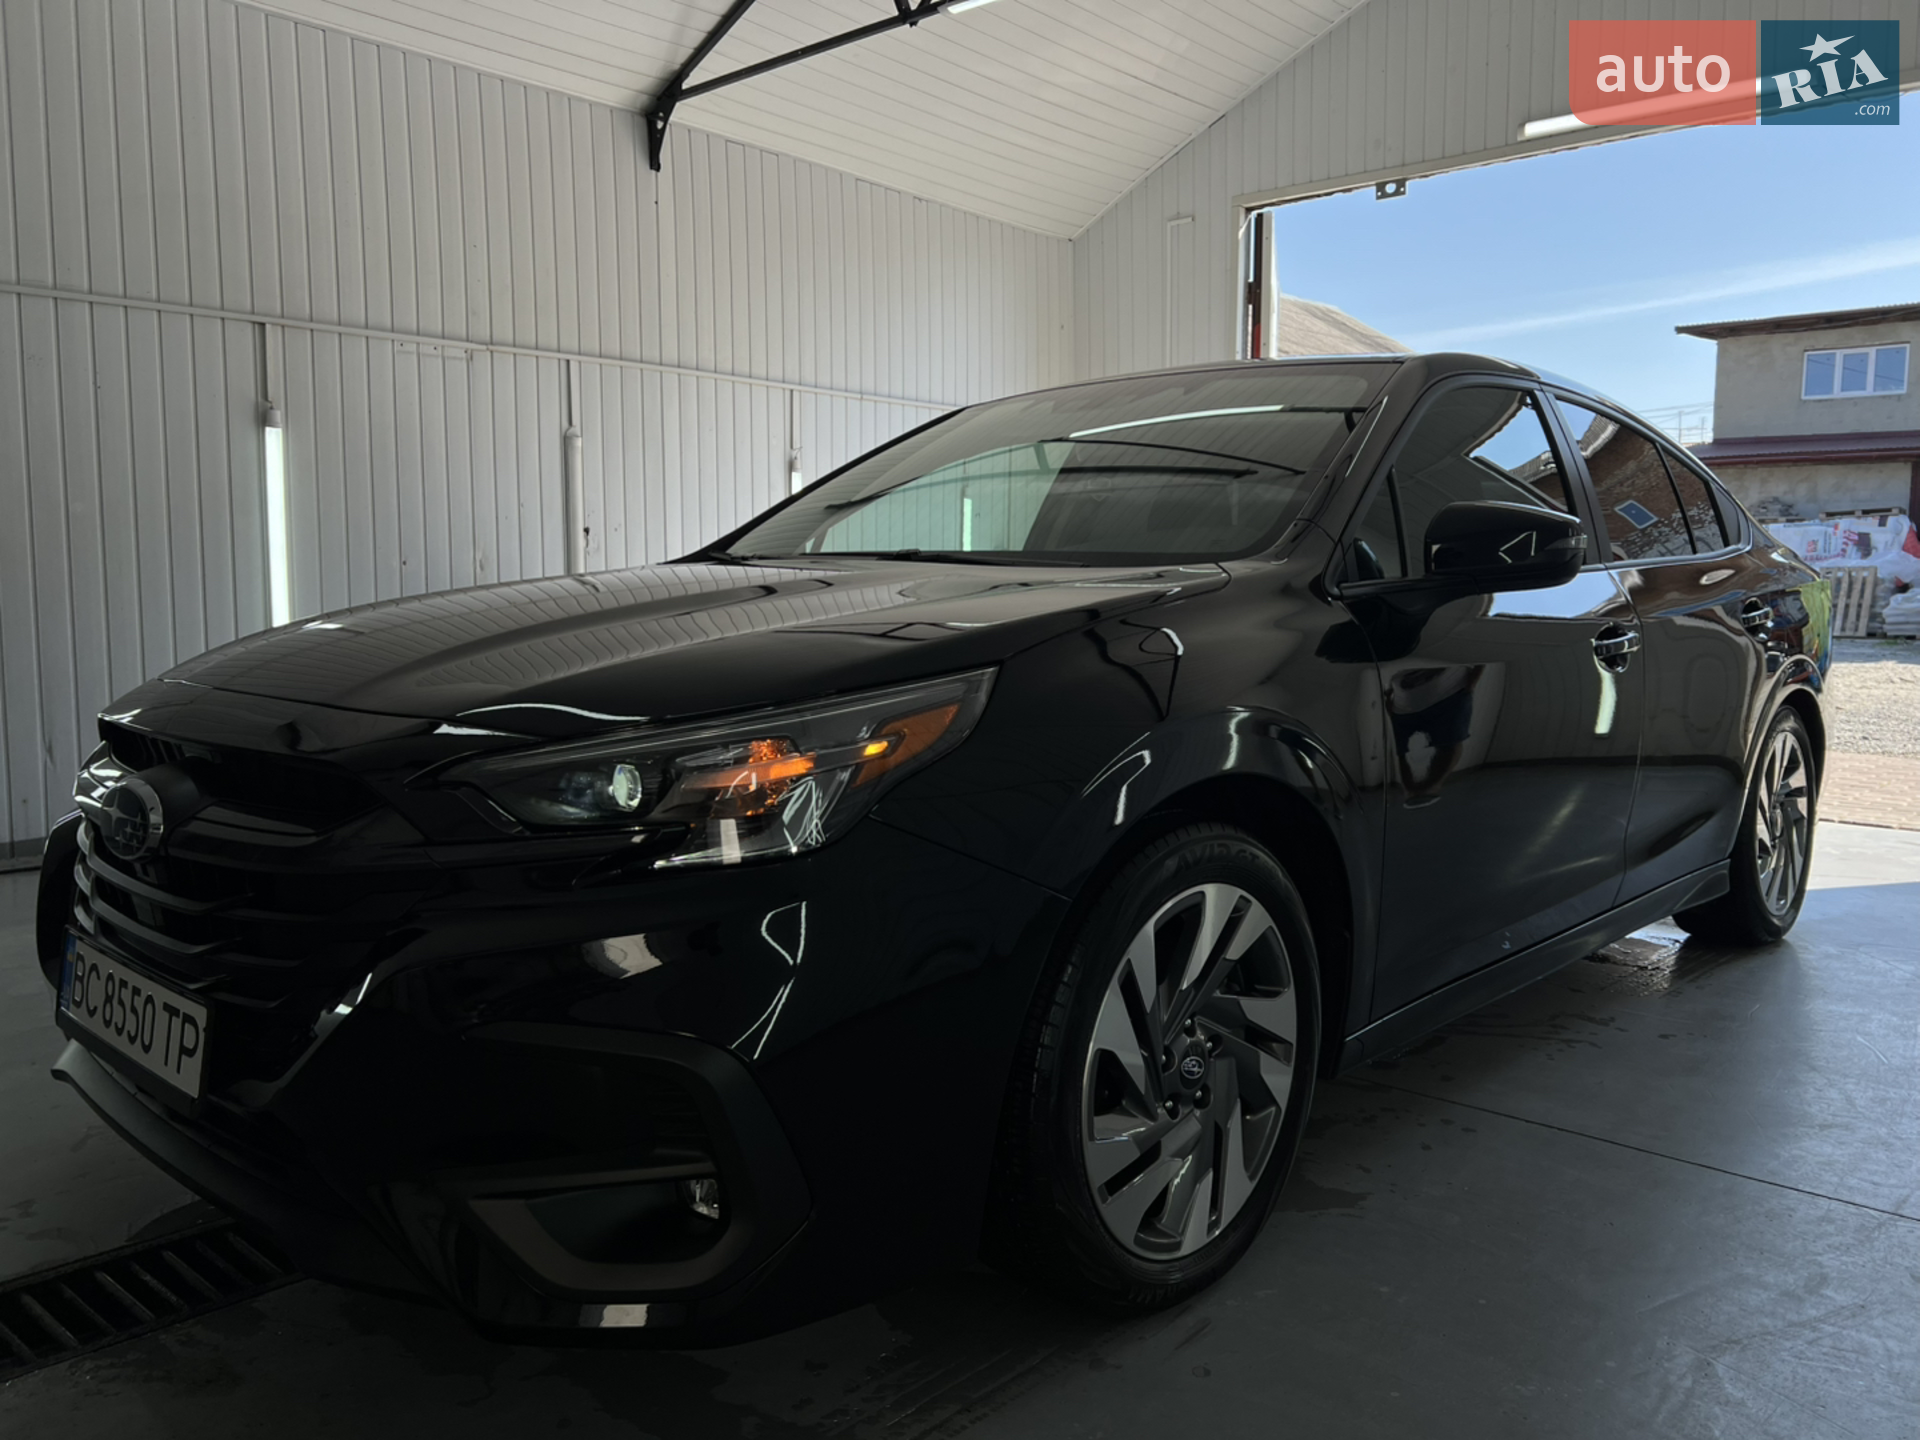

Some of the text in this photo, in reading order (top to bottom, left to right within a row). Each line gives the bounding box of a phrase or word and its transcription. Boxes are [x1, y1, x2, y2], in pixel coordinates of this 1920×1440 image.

[71, 951, 199, 1075] BC 8550 TP
